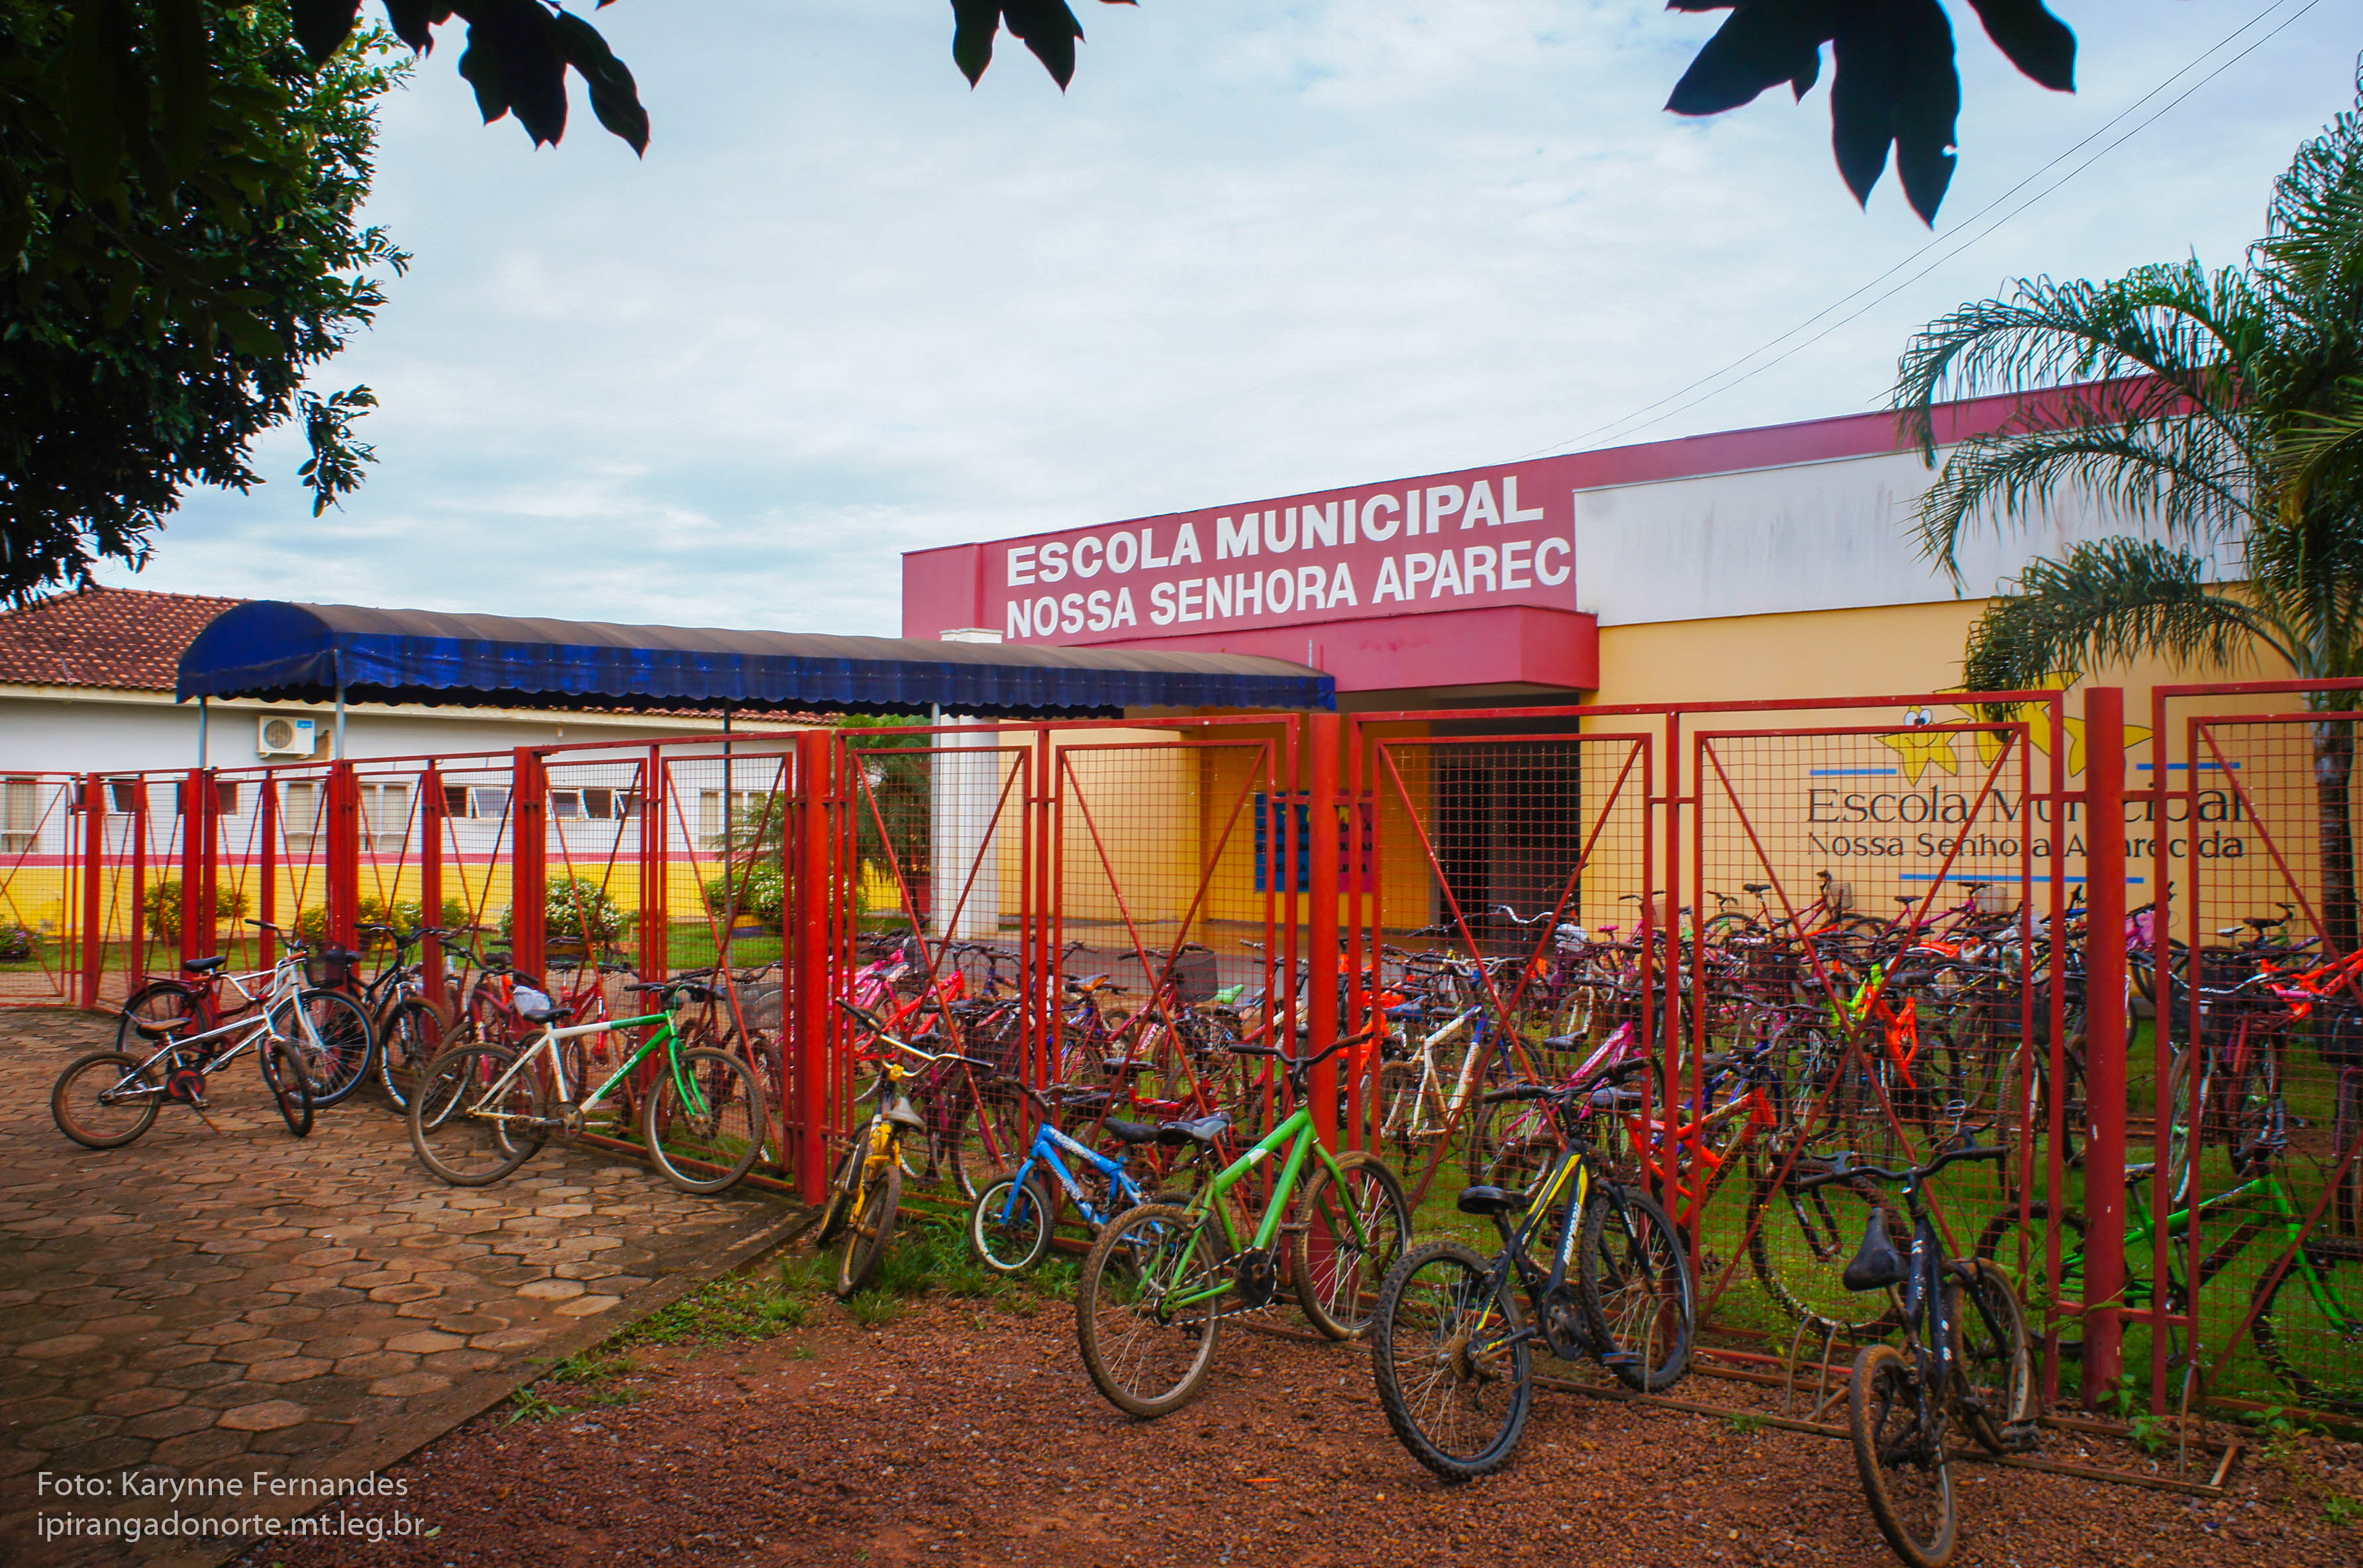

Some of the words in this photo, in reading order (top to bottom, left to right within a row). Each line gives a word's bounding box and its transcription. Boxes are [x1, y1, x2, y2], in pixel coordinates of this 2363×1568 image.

[1007, 522, 1203, 587] ESCOLA
[1216, 475, 1544, 560] MUNICIPAL
[1007, 587, 1137, 639] NOSSA
[1150, 562, 1358, 625] SENHORA
[1372, 537, 1572, 604] APAREC
[1807, 784, 1968, 823] Escola
[1807, 831, 1904, 857] Nossa
[1917, 832, 2052, 858] Senhoa
[2064, 830, 2245, 859] Arecda
